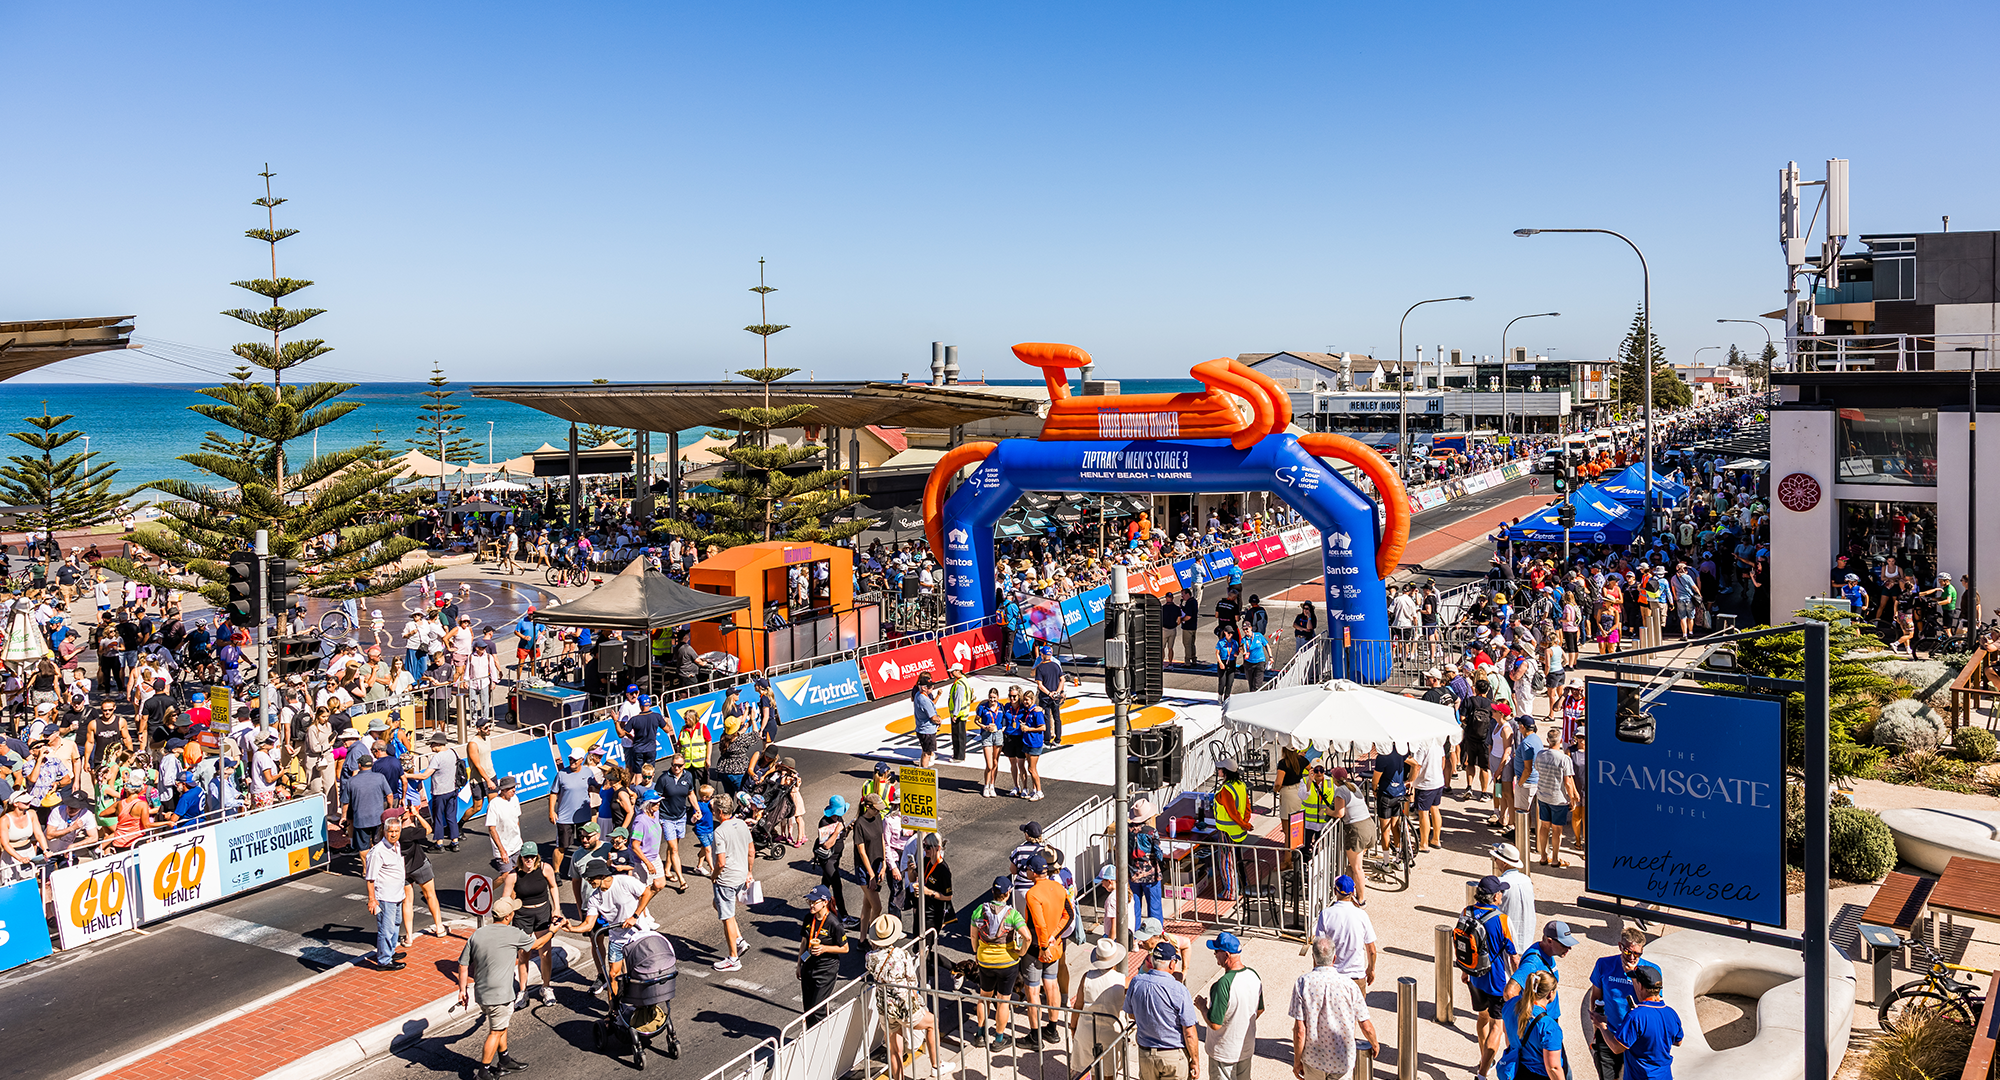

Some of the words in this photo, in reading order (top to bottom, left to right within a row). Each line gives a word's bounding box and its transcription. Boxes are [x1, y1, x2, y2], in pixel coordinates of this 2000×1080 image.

[1351, 401, 1378, 410] HENLEY
[1381, 401, 1405, 410] HOUS
[1098, 413, 1121, 438] TOUR
[1121, 412, 1149, 438] DOWN
[1149, 411, 1180, 437] UNDER
[1125, 451, 1152, 469] MEN'S
[1154, 451, 1181, 469] STAGE
[1182, 451, 1189, 469] 3
[1080, 471, 1115, 479] HENLEY
[1301, 466, 1321, 474] Santos
[1298, 482, 1319, 490] under
[945, 557, 973, 566] Santos
[1326, 565, 1359, 575] Santos
[954, 599, 976, 607] Ziptrak
[1088, 596, 1107, 613] Sant
[1064, 608, 1082, 626] antos
[1339, 612, 1366, 621] Ziptrak
[971, 640, 998, 655] ADELAIDE
[900, 658, 935, 675] ADELAIDE
[808, 677, 858, 705] Ziptrak
[212, 705, 228, 714] KEEP
[212, 713, 228, 722] CLEAR
[1667, 750, 1695, 761] THE
[506, 762, 548, 789] trak
[900, 768, 935, 778] PEDESTRIAN
[900, 774, 919, 782] CROSS
[1598, 759, 1771, 809] RAMSGATE
[903, 793, 933, 805] KEEP
[903, 803, 934, 817] CLEAR
[1656, 803, 1707, 819] HOTEL
[228, 832, 255, 848] SANTOS
[255, 828, 272, 840] TOUR
[273, 822, 292, 835] DOWN
[292, 815, 313, 829] UNDER
[229, 846, 244, 864] AT
[246, 839, 269, 858] THE
[270, 825, 314, 851] SQUARE
[1612, 850, 1673, 873] meet
[1669, 861, 1711, 878] me
[153, 846, 206, 900] GO
[1647, 872, 1668, 898] by
[1673, 877, 1704, 897] the
[1706, 882, 1760, 901] sea
[70, 871, 126, 928] GO
[162, 883, 202, 907] HENLEY
[81, 909, 123, 935] HENLEY
